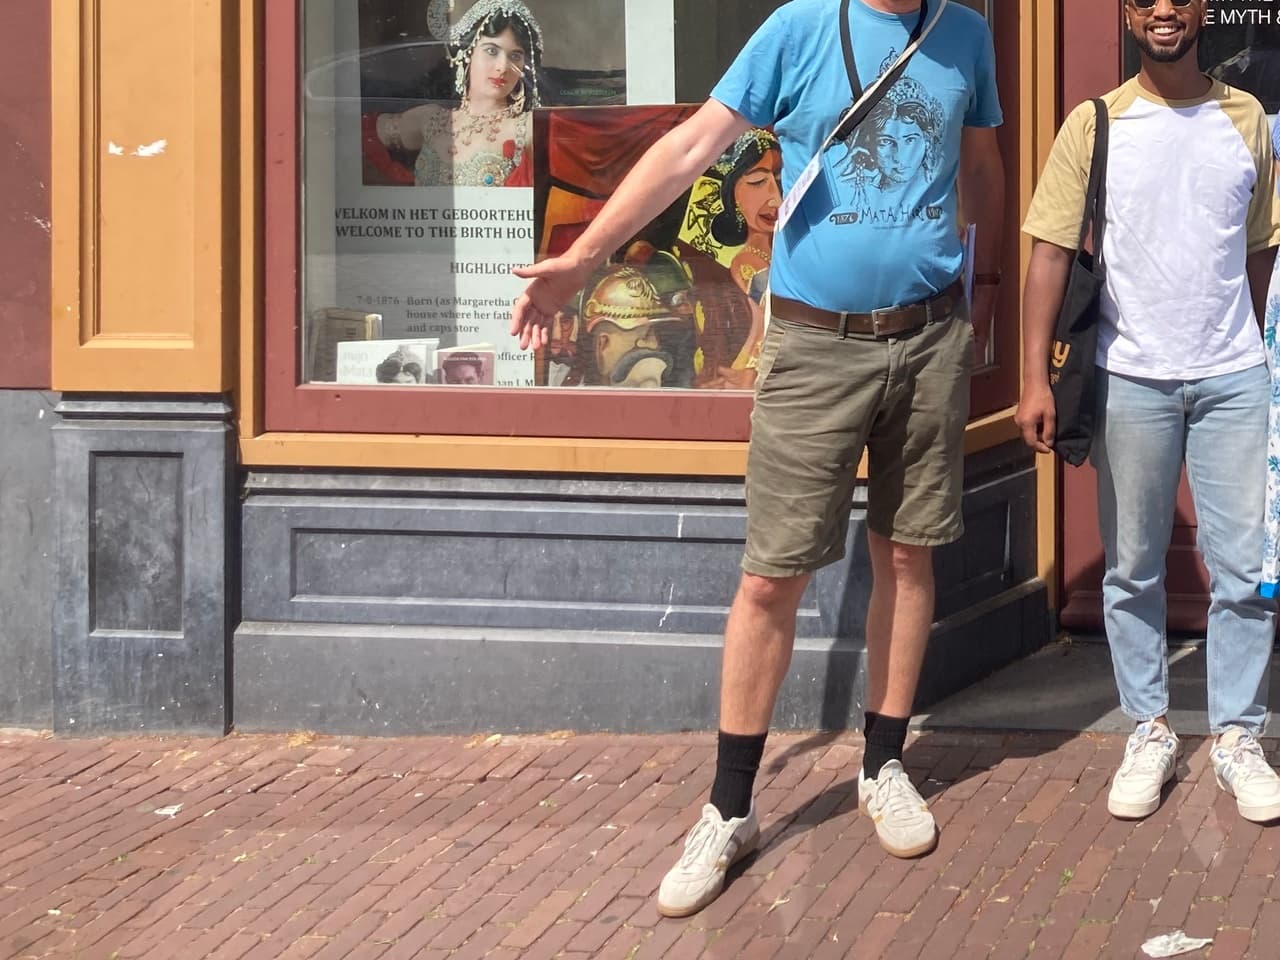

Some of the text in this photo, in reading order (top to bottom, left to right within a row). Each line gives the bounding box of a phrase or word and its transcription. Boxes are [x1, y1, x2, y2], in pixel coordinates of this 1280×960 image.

[1221, 9, 1271, 24] MYTH
[392, 208, 406, 220] IN
[410, 208, 438, 220] HET
[336, 225, 402, 238] WELCOME
[405, 226, 424, 238] TO
[428, 226, 457, 238] THE
[461, 227, 503, 239] BIRTH
[407, 296, 432, 306] Born
[435, 297, 450, 307] (as
[453, 296, 510, 307] Margaretha
[407, 309, 438, 319] house
[440, 309, 472, 319] where
[474, 310, 491, 319] her
[407, 323, 480, 334] and caps store
